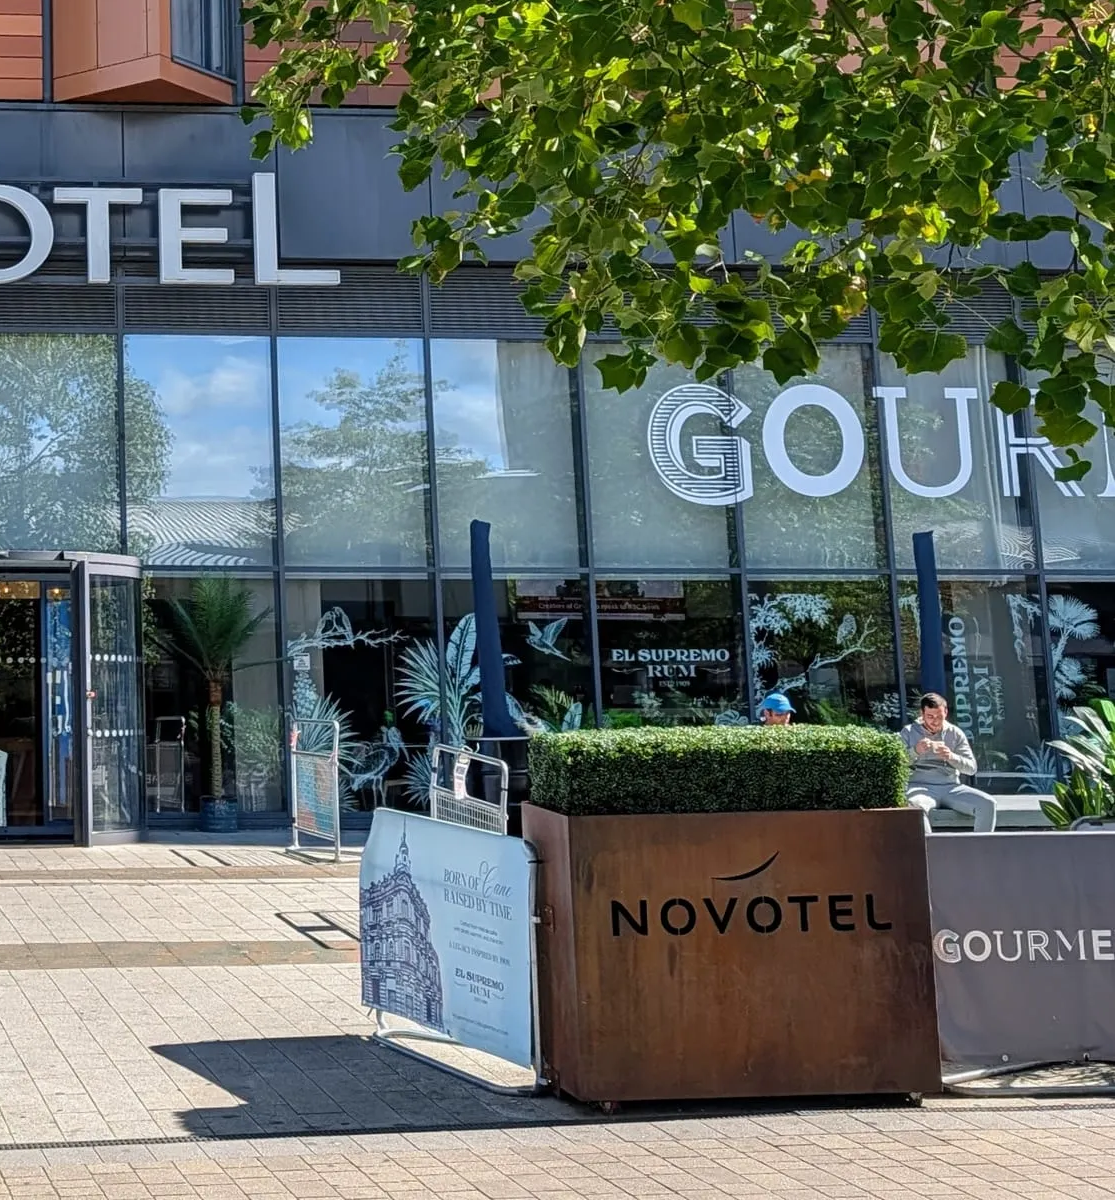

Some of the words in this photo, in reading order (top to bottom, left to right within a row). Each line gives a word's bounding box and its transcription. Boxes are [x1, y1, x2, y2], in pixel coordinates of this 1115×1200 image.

[612, 648, 635, 662] EL
[637, 648, 730, 662] SUPREMO
[647, 664, 697, 678] RUM
[973, 666, 994, 736] RUM
[444, 868, 466, 887] BORN
[468, 875, 481, 891] OF
[444, 887, 475, 909] RAISED
[476, 897, 489, 913] BY
[489, 901, 513, 921] TIME
[611, 893, 893, 936] NOVOTEL
[455, 967, 465, 978] EL
[466, 971, 504, 992] SUPREMO
[469, 983, 491, 999] RUM
